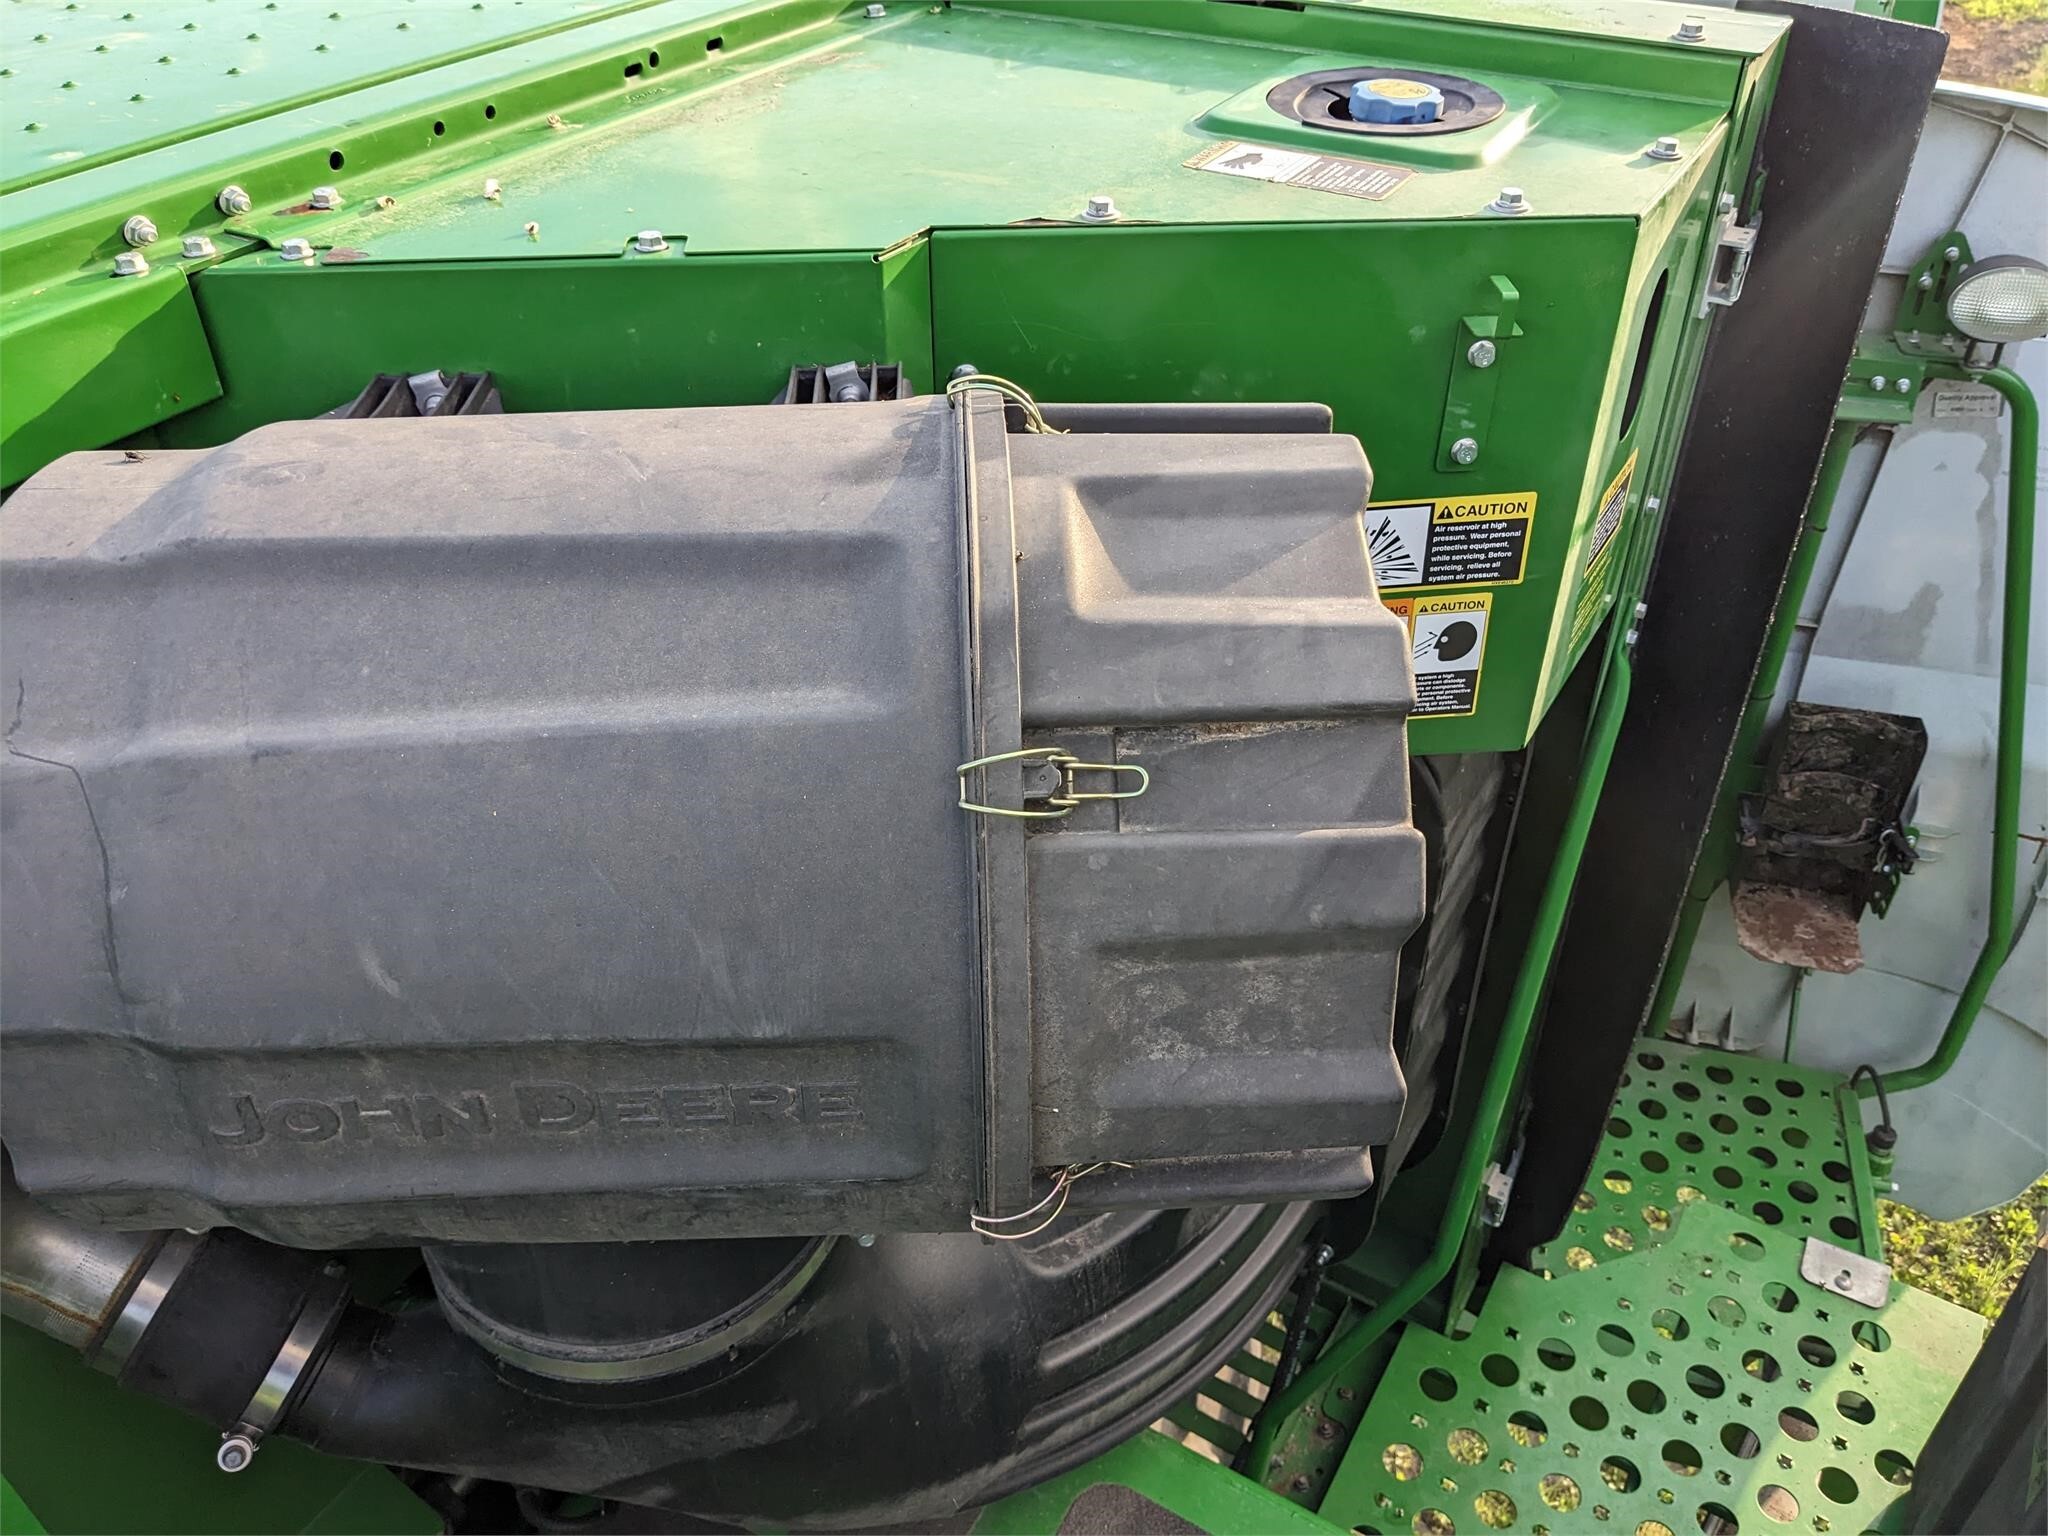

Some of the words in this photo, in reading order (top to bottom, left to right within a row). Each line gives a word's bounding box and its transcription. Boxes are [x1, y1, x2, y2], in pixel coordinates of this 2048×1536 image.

[1455, 502, 1528, 517] CAUTION
[1447, 524, 1480, 532] reservoir
[1490, 522, 1507, 530] high
[1433, 535, 1467, 543] pressure.
[1490, 530, 1521, 539] personal
[1428, 574, 1454, 583] system
[1467, 572, 1500, 581] pressure.
[1431, 600, 1485, 612] CAUTION
[206, 1091, 496, 1146] JOHN
[513, 1080, 865, 1132] DEERE
